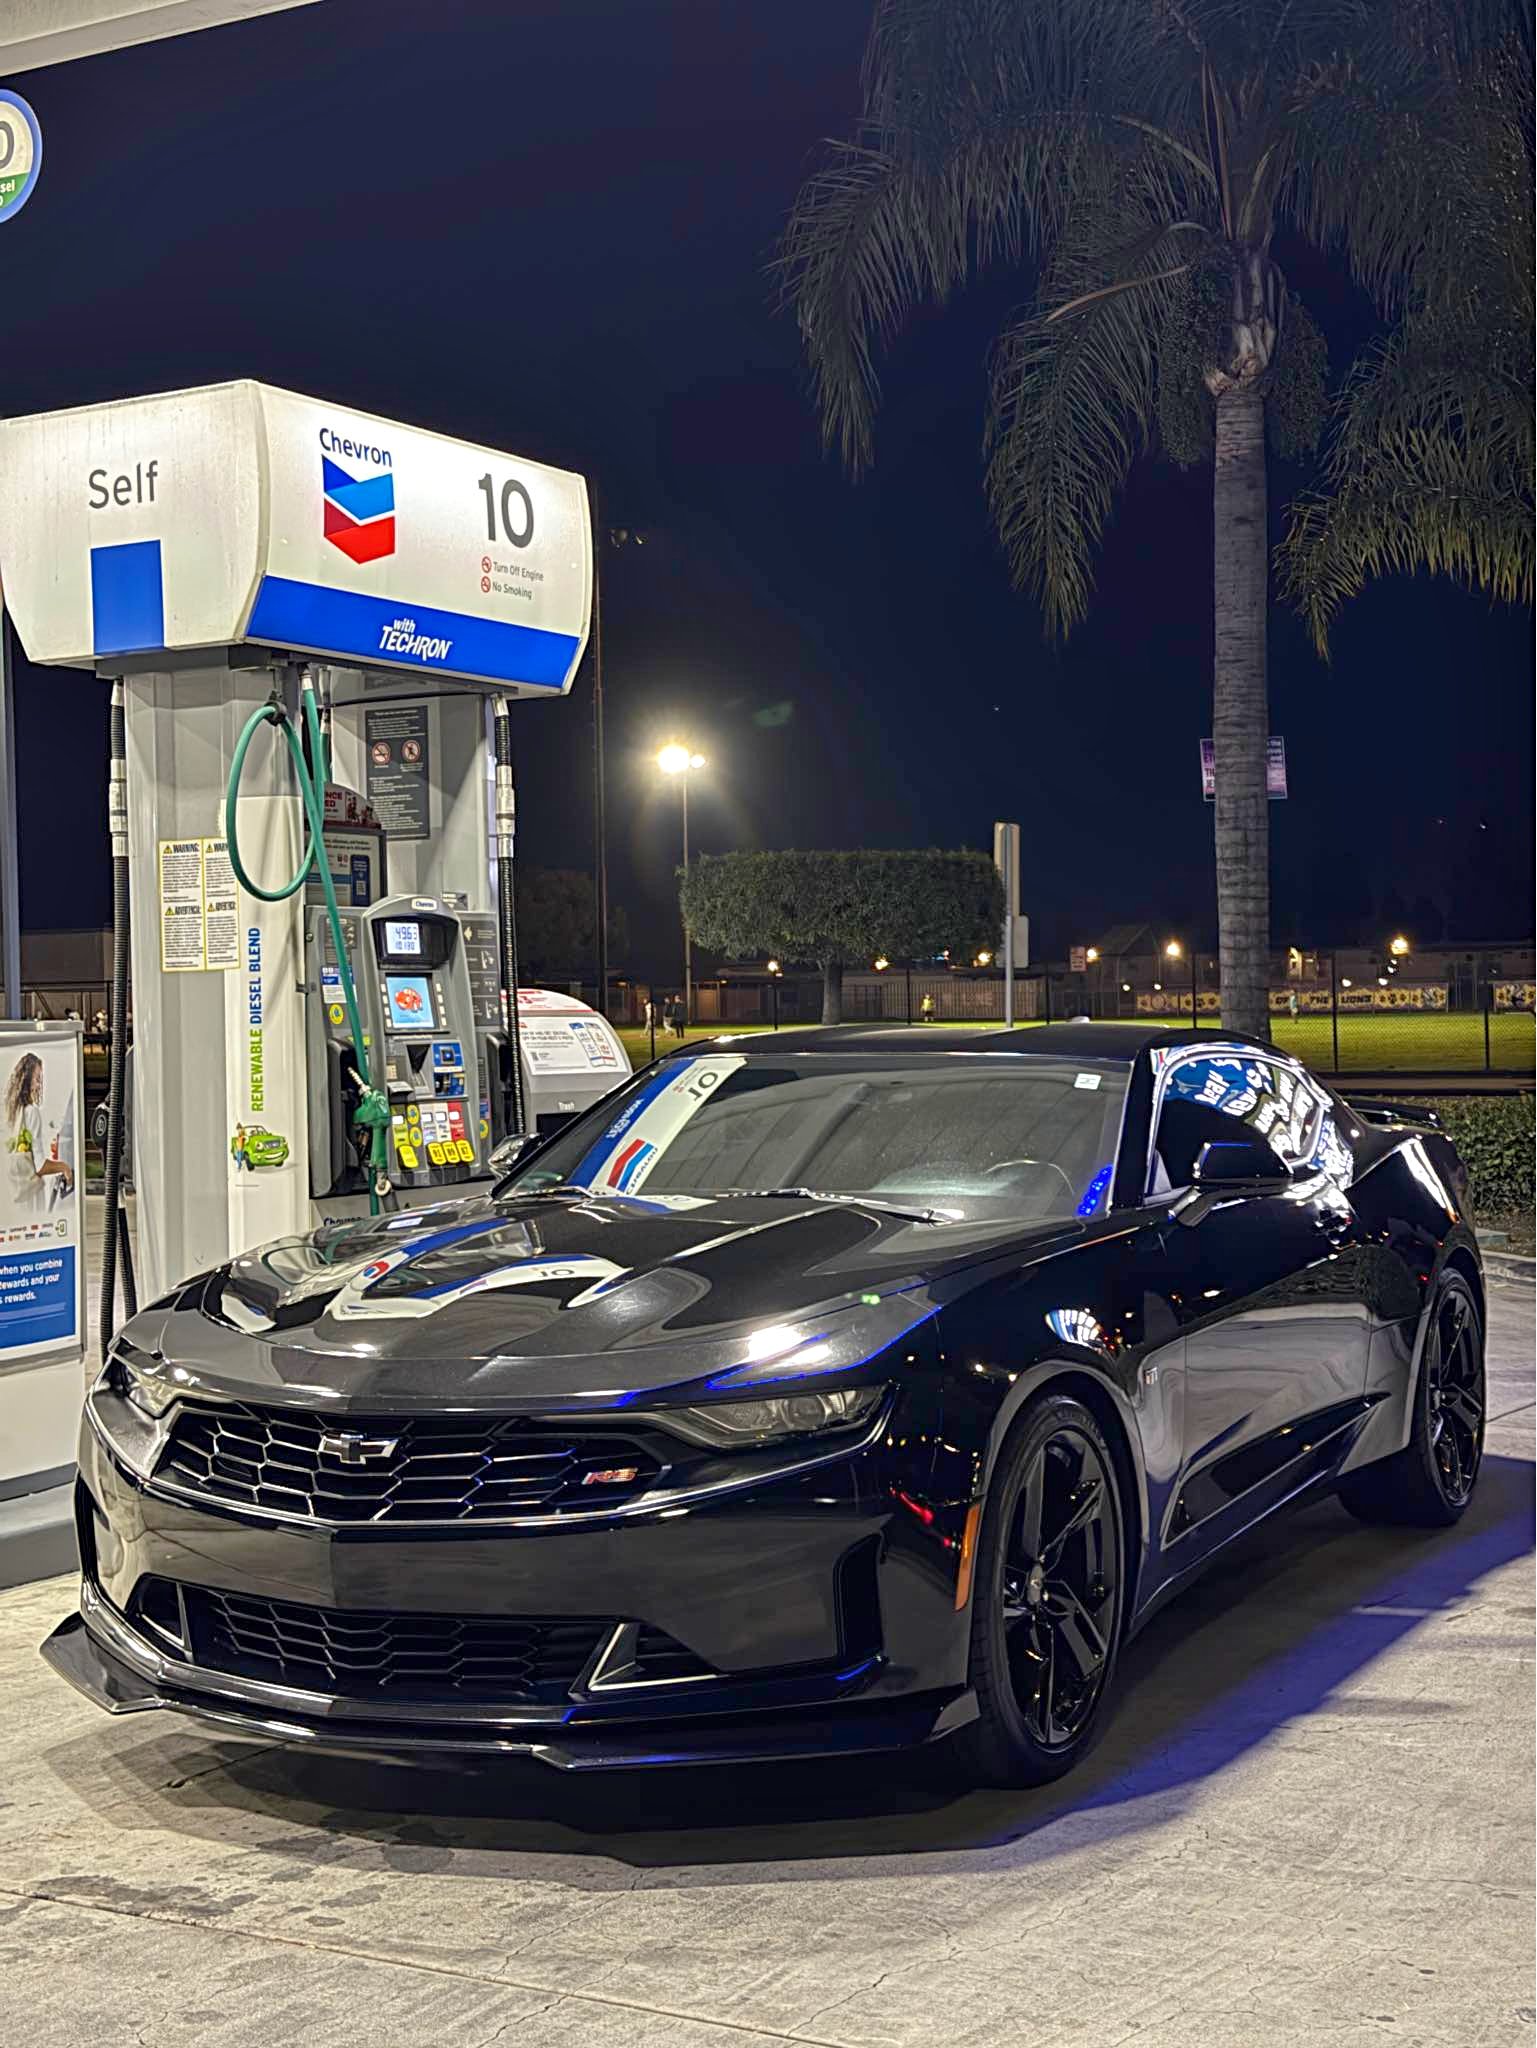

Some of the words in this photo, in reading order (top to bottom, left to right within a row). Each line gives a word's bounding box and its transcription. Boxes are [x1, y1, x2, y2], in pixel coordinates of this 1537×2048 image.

[319, 427, 393, 468] Chevron
[88, 459, 158, 509] Self
[478, 472, 534, 549] 10
[493, 561, 509, 574] Turn
[510, 564, 521, 577] Off
[521, 567, 544, 582] Engine
[492, 581, 502, 593] No
[503, 583, 533, 601] Smoking
[379, 625, 453, 662] TECHRON
[393, 617, 416, 633] with
[248, 927, 261, 973] BLEND
[249, 977, 262, 1024] DIESEL
[251, 1028, 264, 1112] RENEWABLE
[558, 1101, 575, 1112] Trash
[20, 1263, 34, 1275] you
[35, 1258, 63, 1271] combine
[31, 1273, 44, 1286] and
[45, 1273, 60, 1285] your
